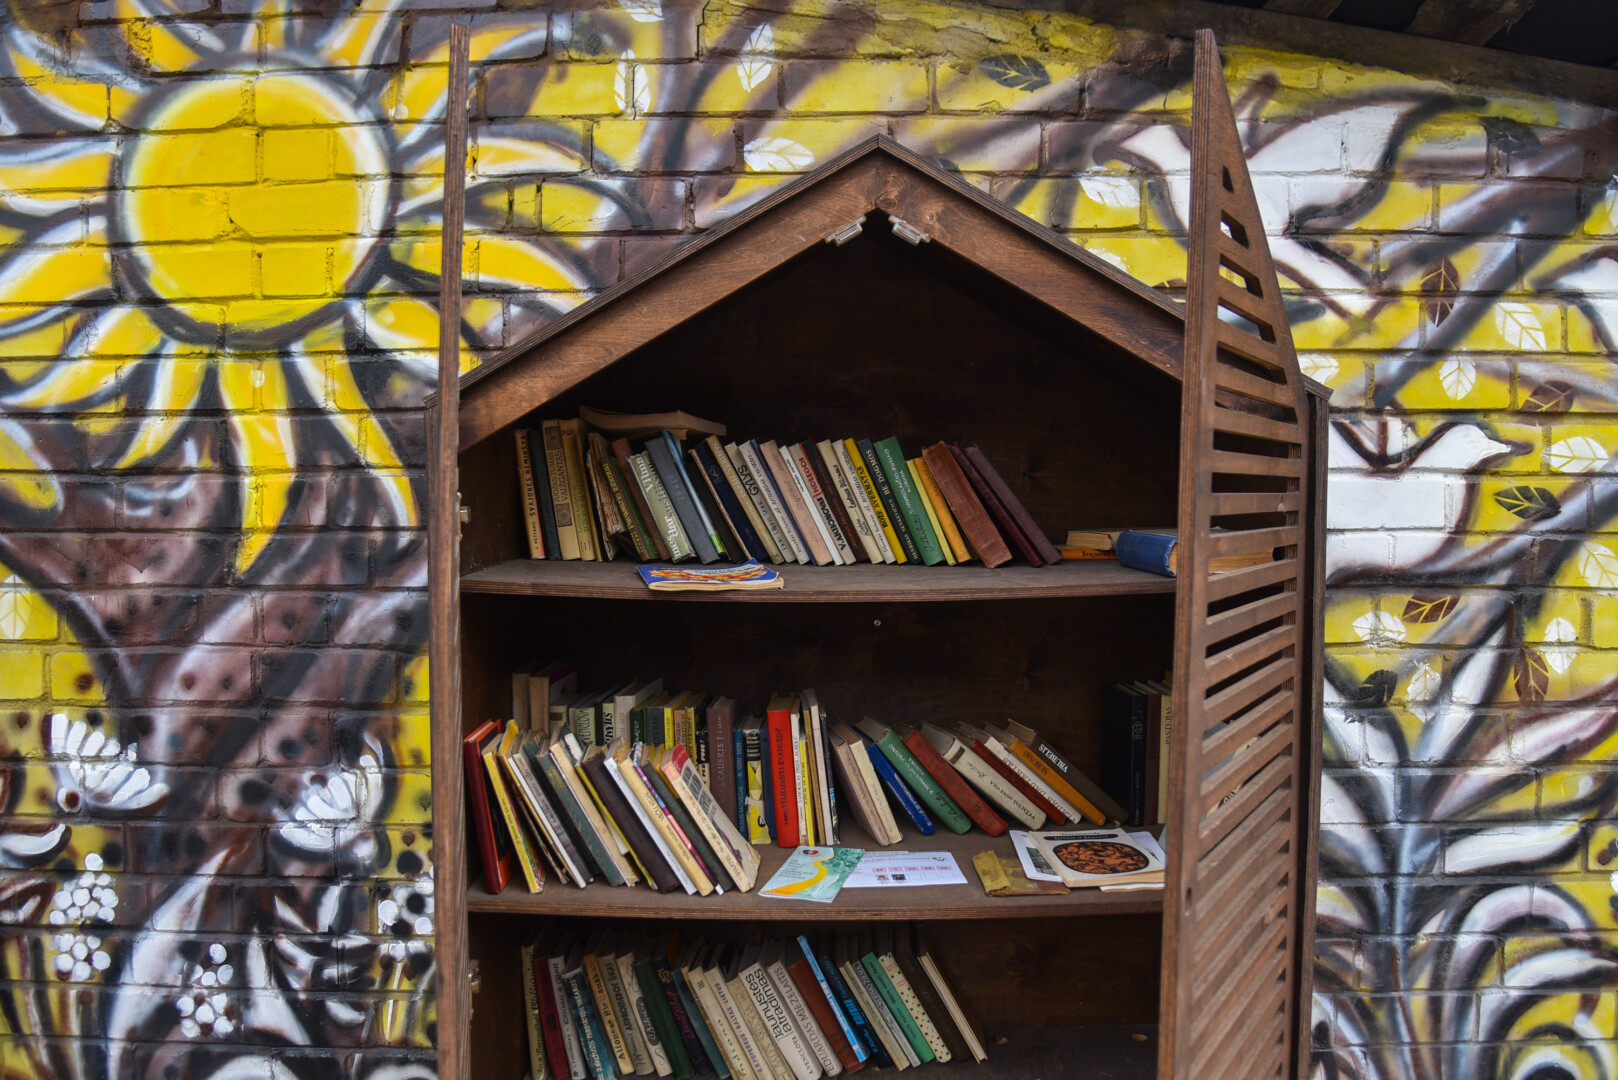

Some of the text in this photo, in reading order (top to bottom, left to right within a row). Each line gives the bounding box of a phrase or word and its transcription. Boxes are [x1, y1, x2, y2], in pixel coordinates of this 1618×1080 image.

[547, 451, 560, 503] JUOZAS TUMAS
[633, 455, 655, 493] Vilma
[736, 463, 760, 497] GYLYS
[797, 455, 820, 493] KOLEGOS
[864, 448, 885, 483] DOGMOS
[856, 464, 880, 509] AVERMATAS
[881, 484, 891, 495] BE
[662, 514, 679, 538] dar
[664, 533, 681, 559] mes
[903, 532, 918, 560] HENRIKAS
[1036, 741, 1070, 775] VRUBELIS
[568, 977, 584, 1007] VASAROS
[610, 981, 634, 1032] ANDROMEDOS
[713, 981, 729, 1004] LIETUS
[751, 966, 795, 1033] atradimas
[725, 1005, 742, 1030] BALTAS
[802, 1020, 835, 1073] EDUARDAS
